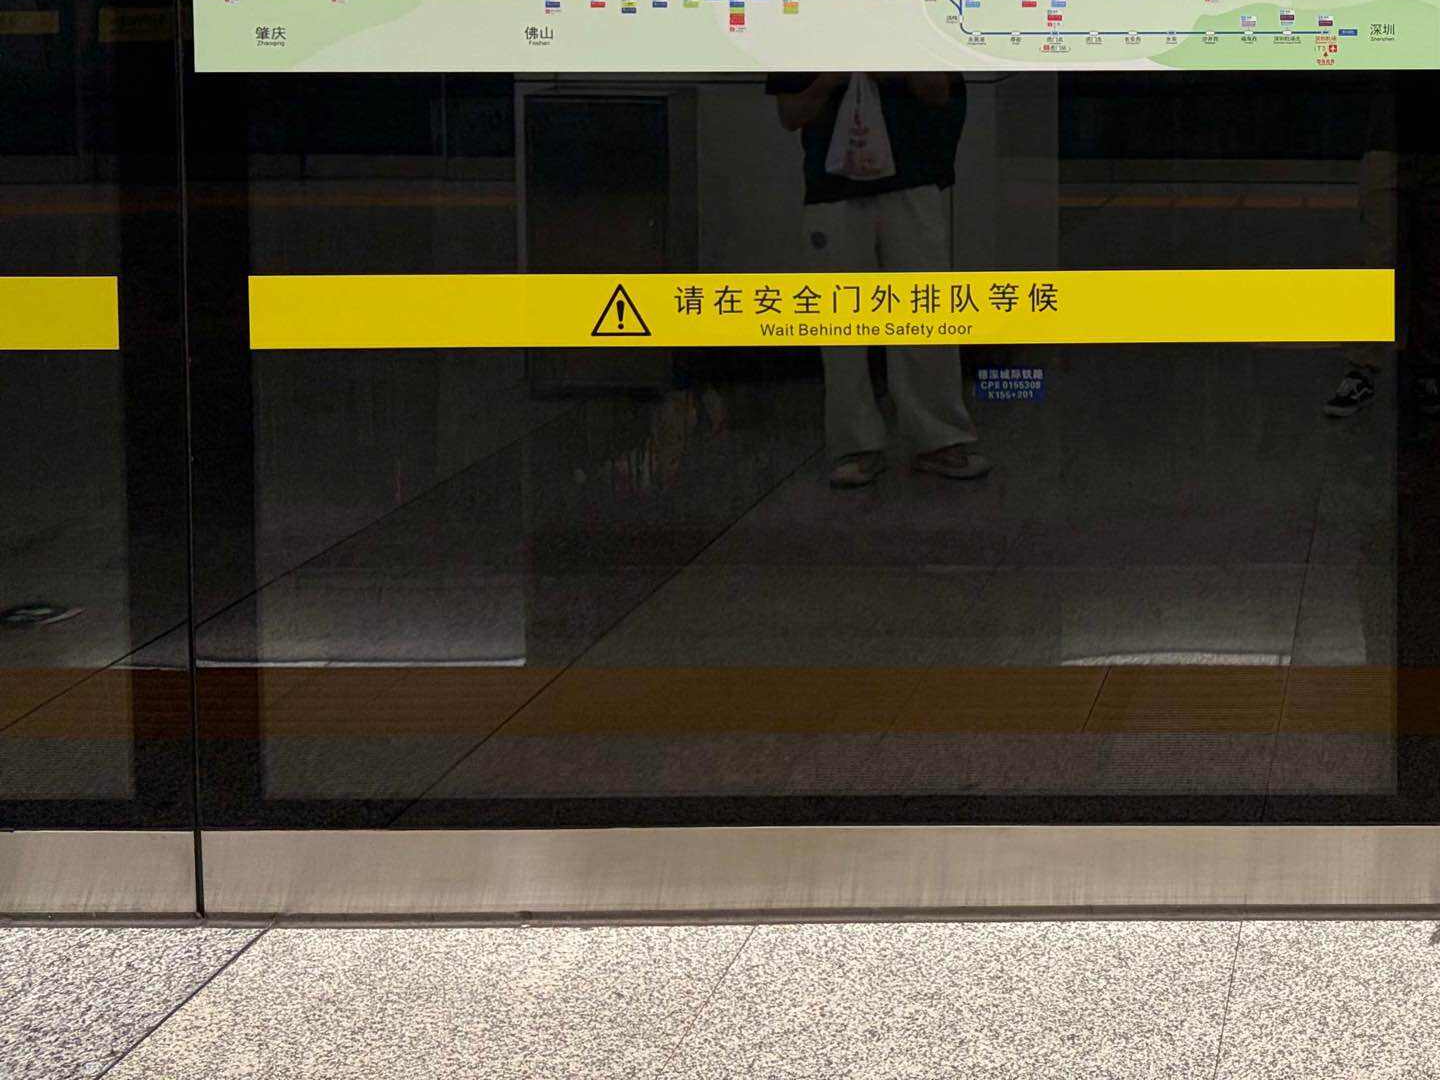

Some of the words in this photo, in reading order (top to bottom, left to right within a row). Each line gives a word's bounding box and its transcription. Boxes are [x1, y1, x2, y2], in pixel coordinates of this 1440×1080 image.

[255, 26, 286, 40] 肇庆
[525, 26, 554, 40] 佛山
[1370, 24, 1395, 36] 深圳
[675, 283, 1057, 315] 请在安全门外排队等候
[761, 324, 793, 336] Wait
[799, 324, 851, 336] Behind
[857, 324, 879, 335] the
[885, 323, 933, 337] Safety
[938, 323, 972, 335] door
